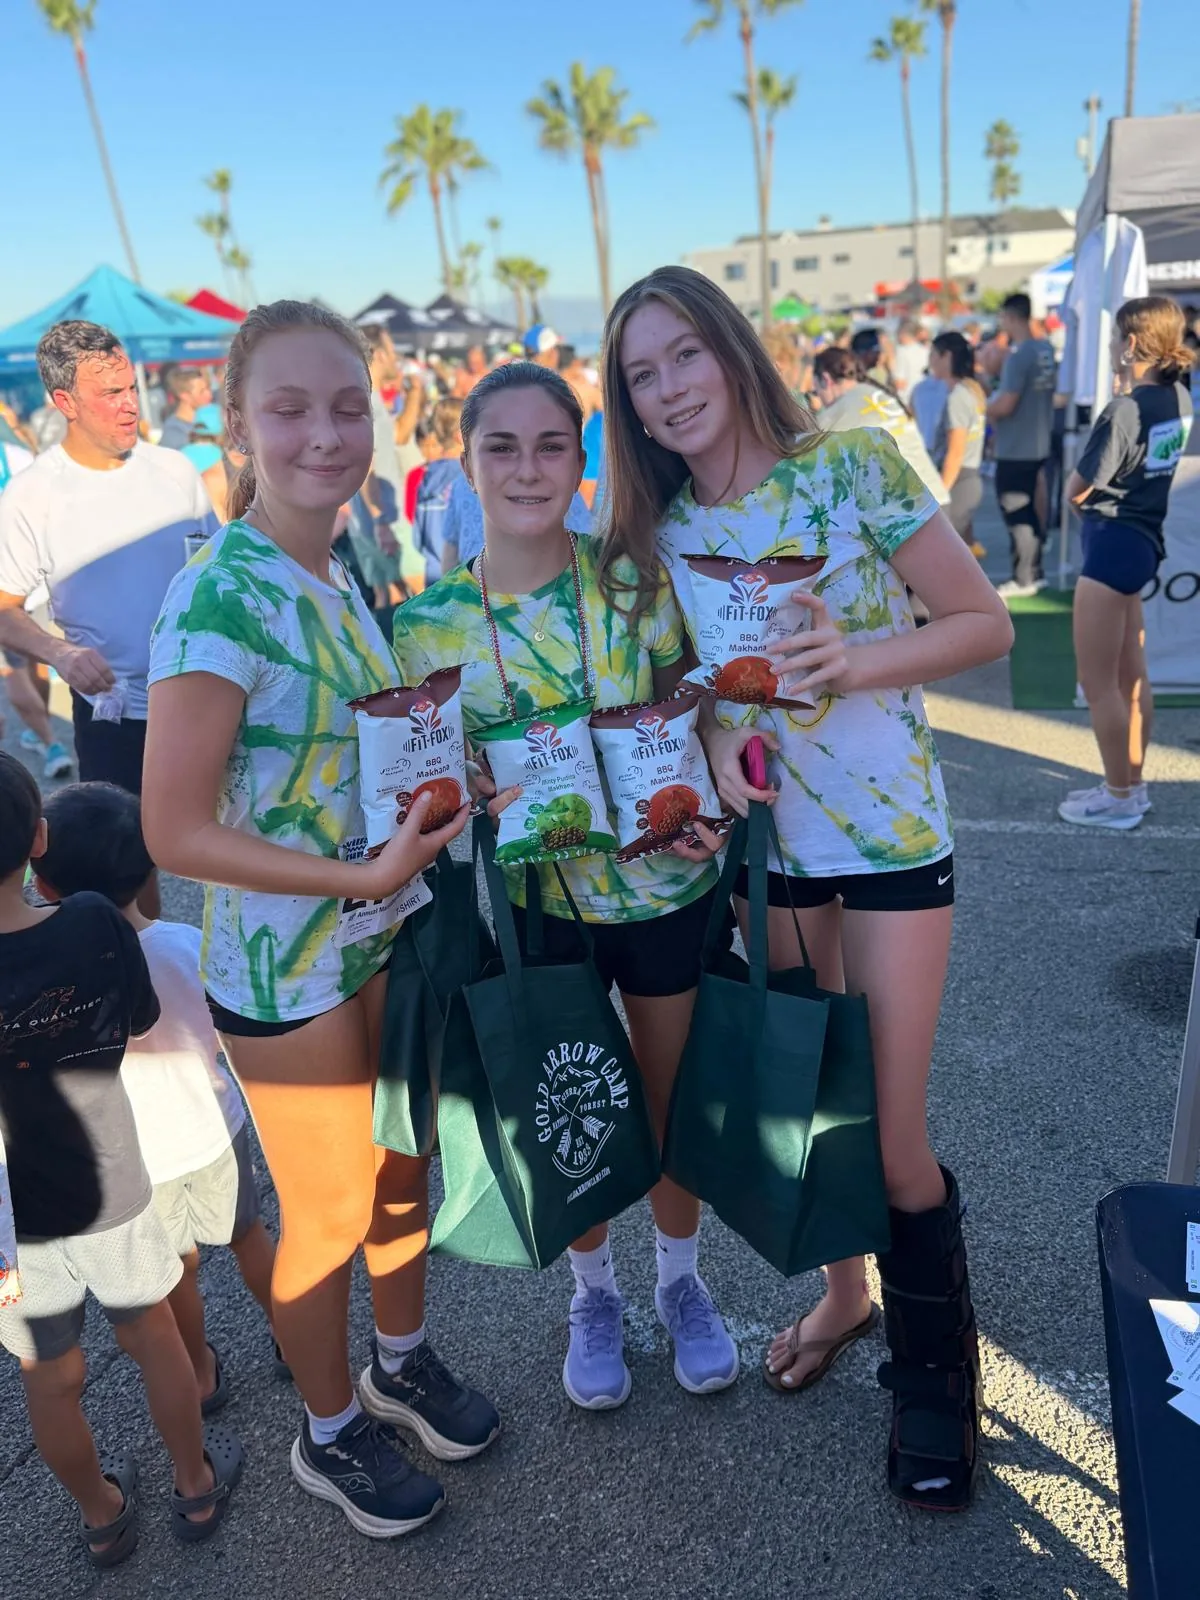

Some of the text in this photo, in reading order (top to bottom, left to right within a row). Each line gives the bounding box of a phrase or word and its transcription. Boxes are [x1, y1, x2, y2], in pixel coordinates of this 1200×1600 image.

[739, 633, 759, 643] BBQ
[728, 643, 767, 654] Makhana
[425, 756, 442, 767] BBQ
[416, 764, 450, 779] Makhana
[656, 764, 674, 775] BBQ
[395, 893, 422, 917] T-SHIRT
[29, 996, 102, 1027] QUALIFIER
[535, 1041, 629, 1143] GOLD ARROW CAMP
[580, 1099, 607, 1113] FOREST
